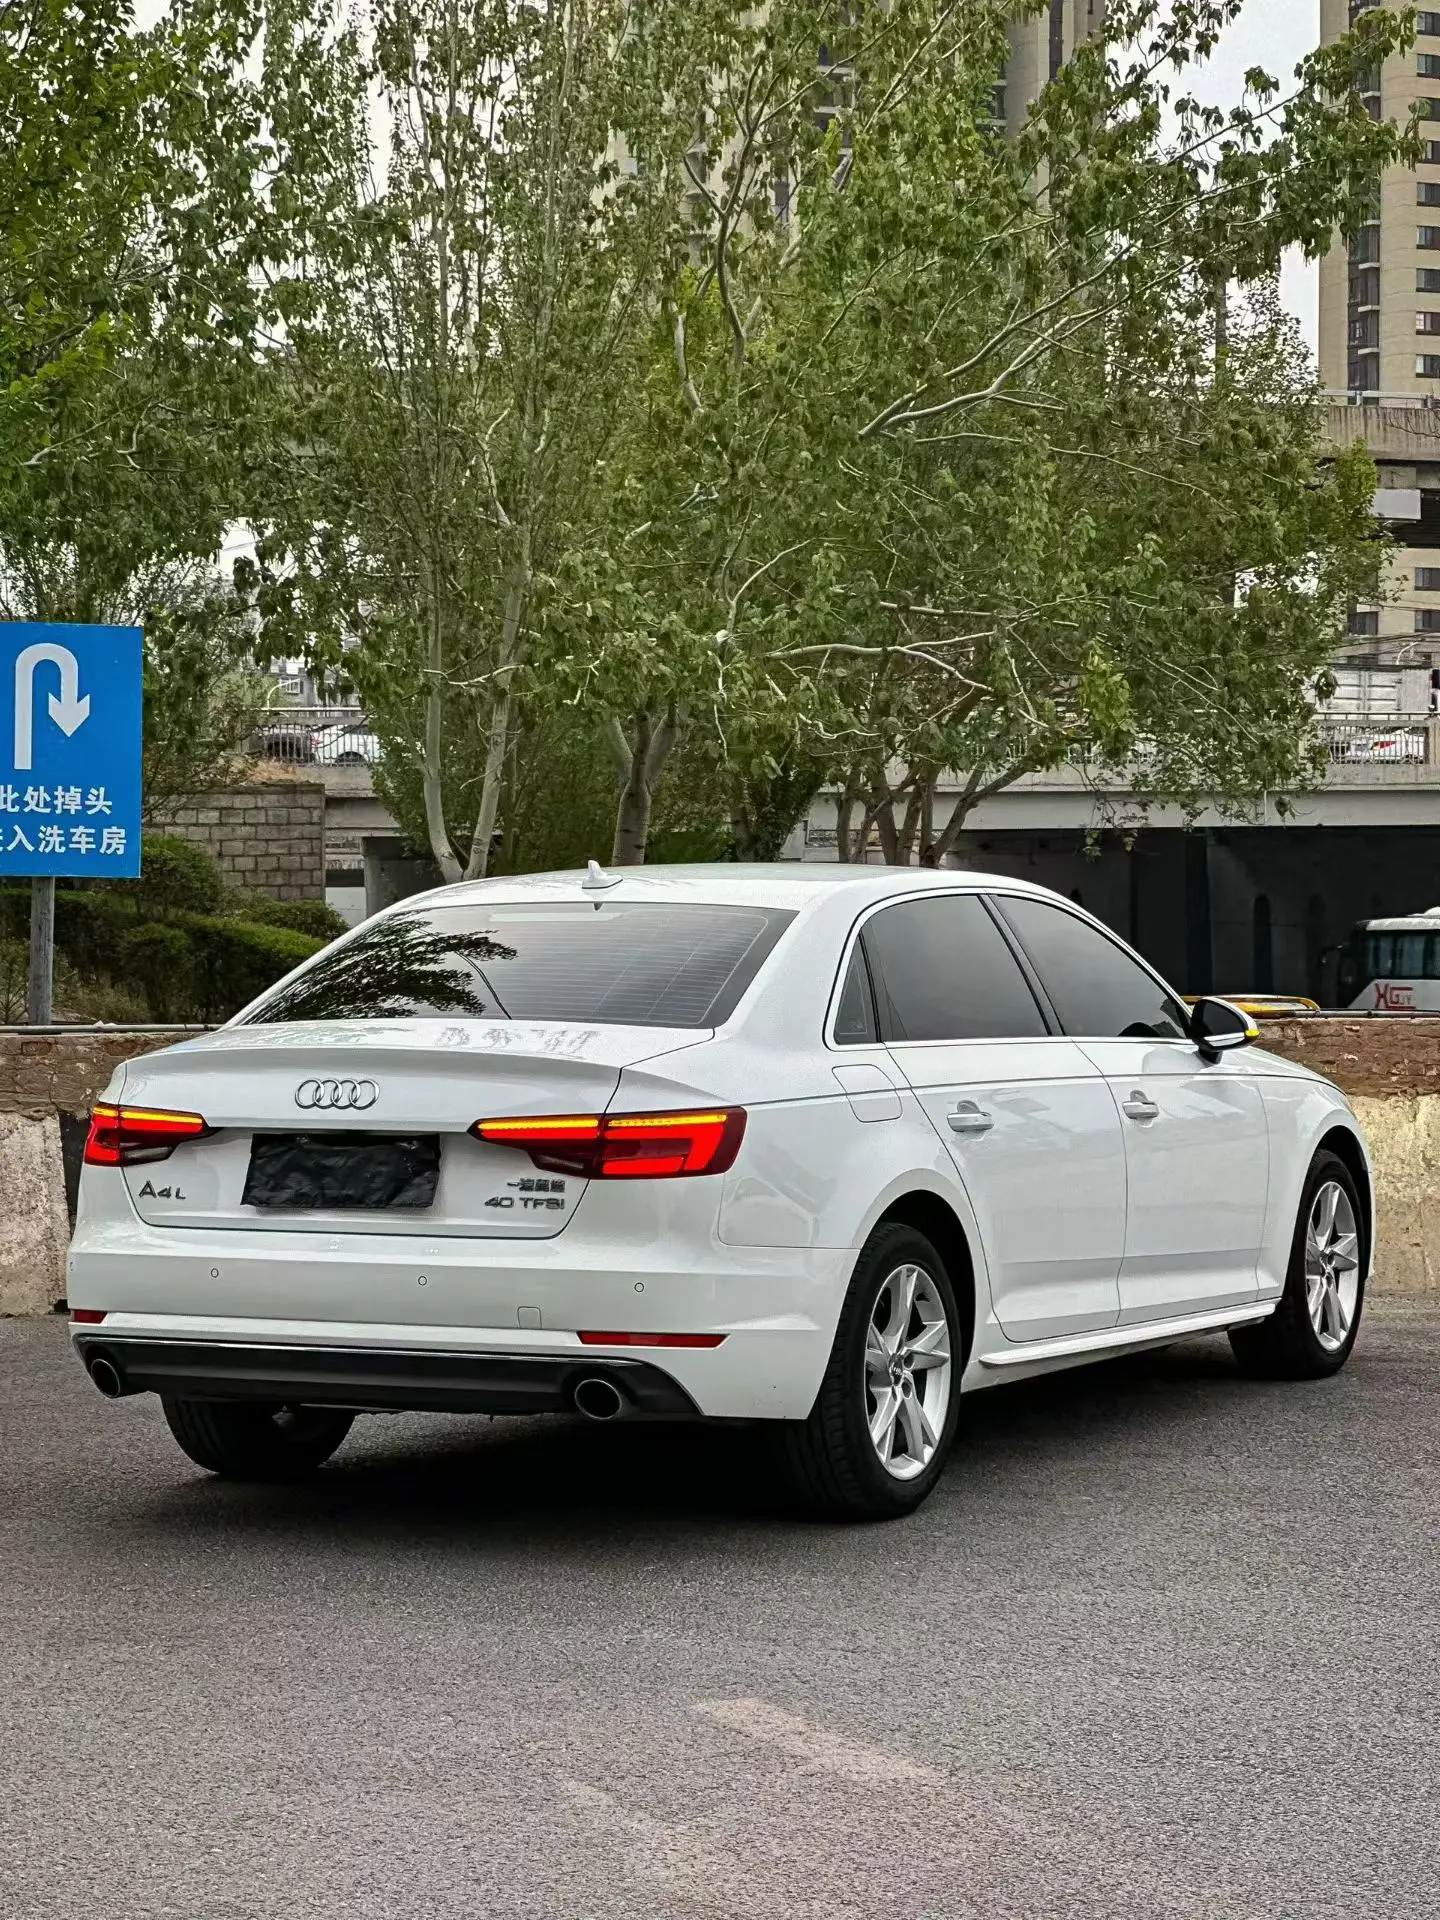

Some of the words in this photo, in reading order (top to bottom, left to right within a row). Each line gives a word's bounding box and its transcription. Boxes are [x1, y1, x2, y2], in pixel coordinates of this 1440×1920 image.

[0, 784, 112, 815] 此处掉头
[0, 824, 127, 855] 入洗车房
[139, 1180, 186, 1200] A4L
[485, 1197, 514, 1208] 40
[519, 1197, 565, 1209] TFSI
